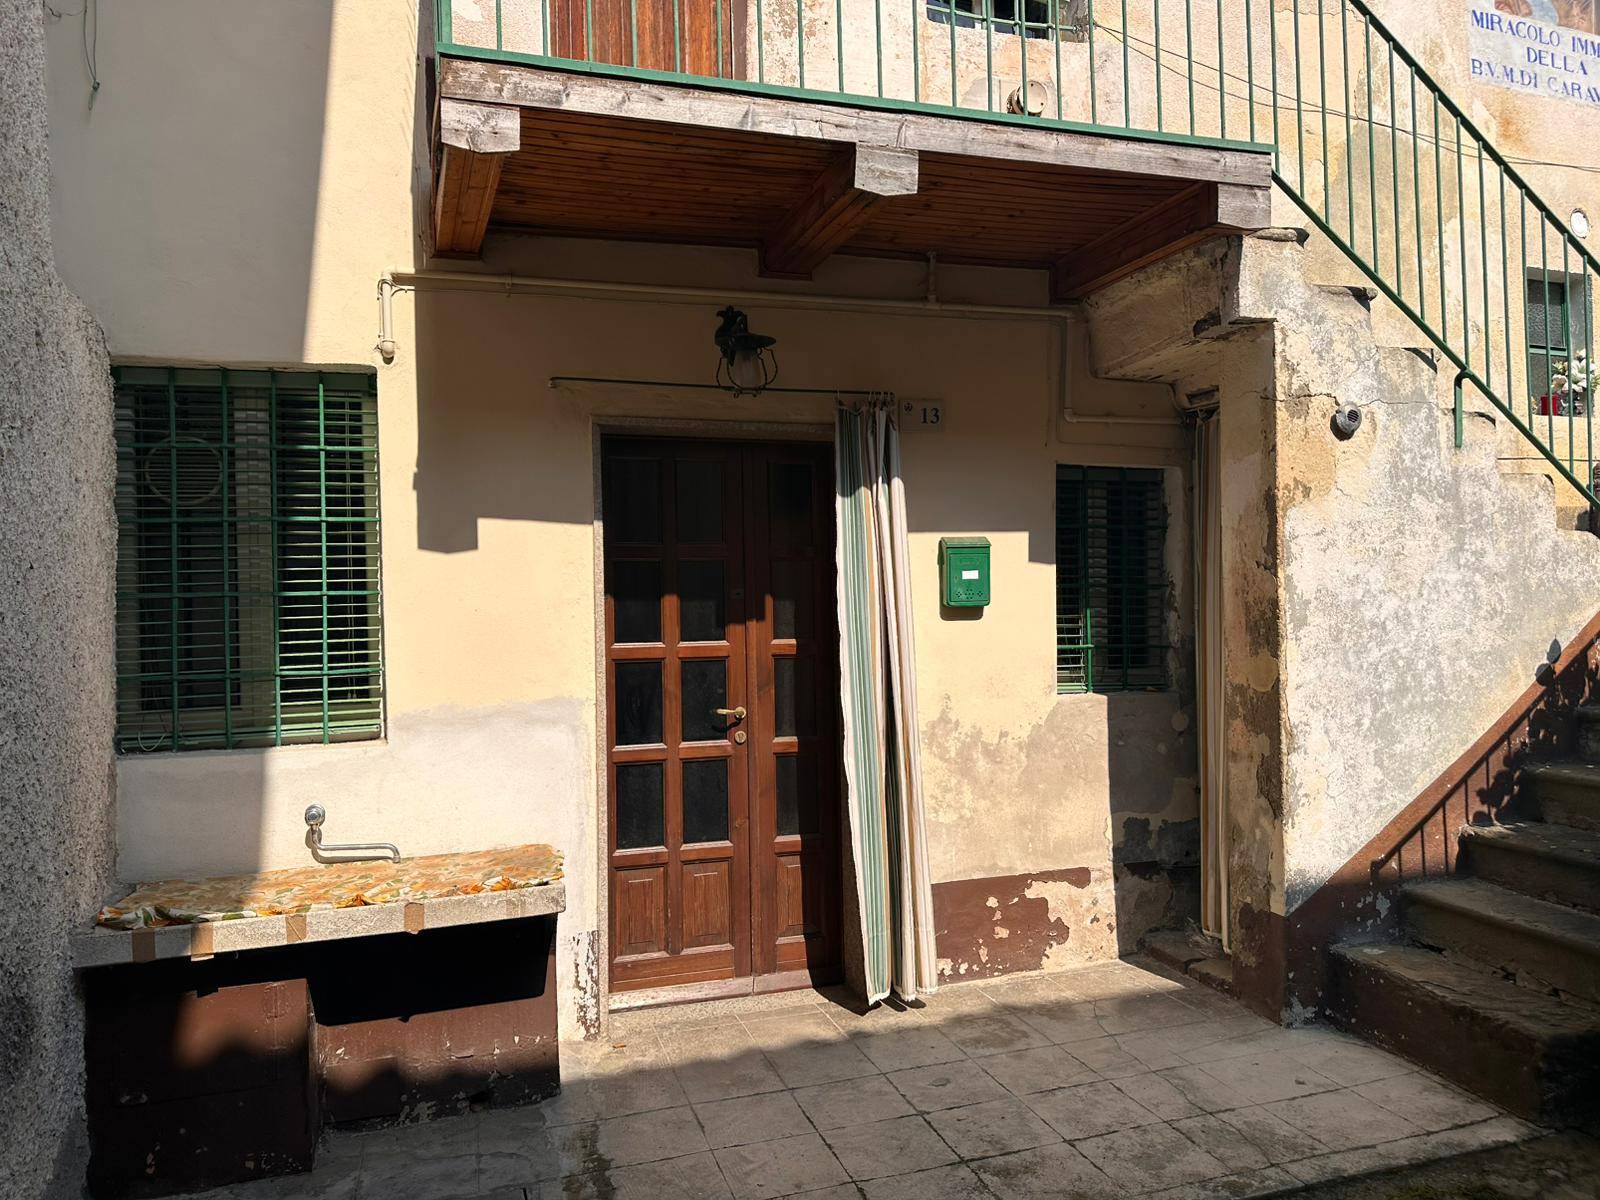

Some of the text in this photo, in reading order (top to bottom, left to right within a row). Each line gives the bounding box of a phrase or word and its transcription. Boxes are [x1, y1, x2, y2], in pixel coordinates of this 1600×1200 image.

[1471, 9, 1560, 47] MIRACOLO
[1526, 46, 1588, 76] DELLA
[920, 407, 940, 424] 13
